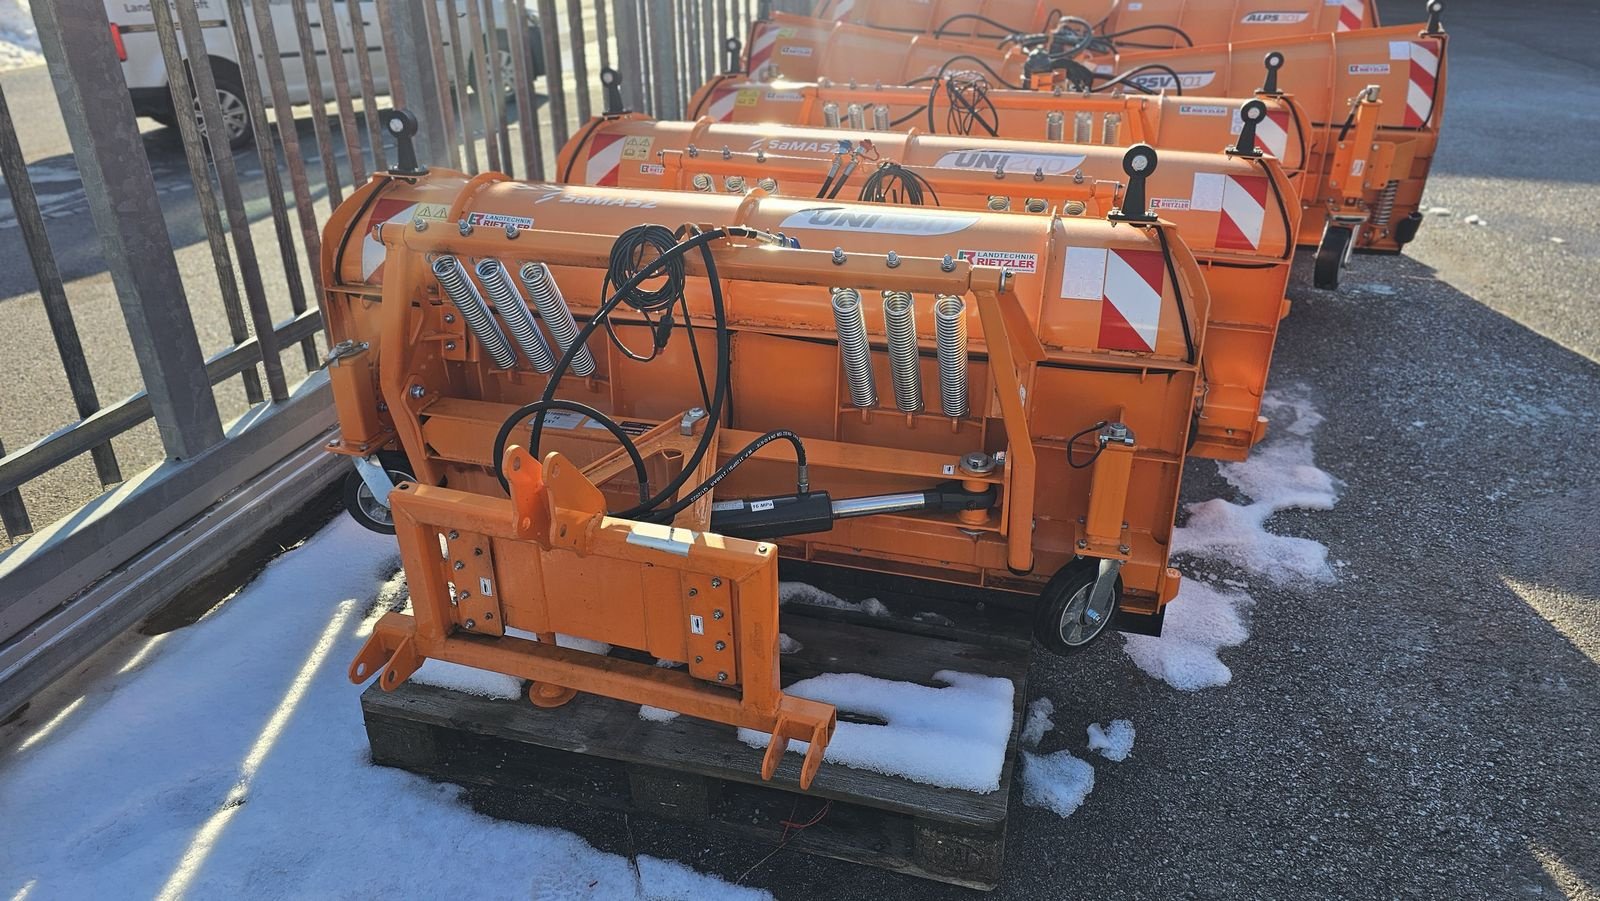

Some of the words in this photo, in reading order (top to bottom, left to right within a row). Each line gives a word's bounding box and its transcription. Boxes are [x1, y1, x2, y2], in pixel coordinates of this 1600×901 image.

[954, 152, 1010, 169] UNI
[1007, 157, 1066, 172] 200
[559, 192, 657, 208] SaMASZ
[483, 219, 530, 230] RIETER
[485, 214, 532, 224] LANDTECHNIK
[808, 210, 881, 229] UNI
[977, 251, 1035, 260] LANDTECHNIK
[977, 258, 1035, 269] RIETZLER
